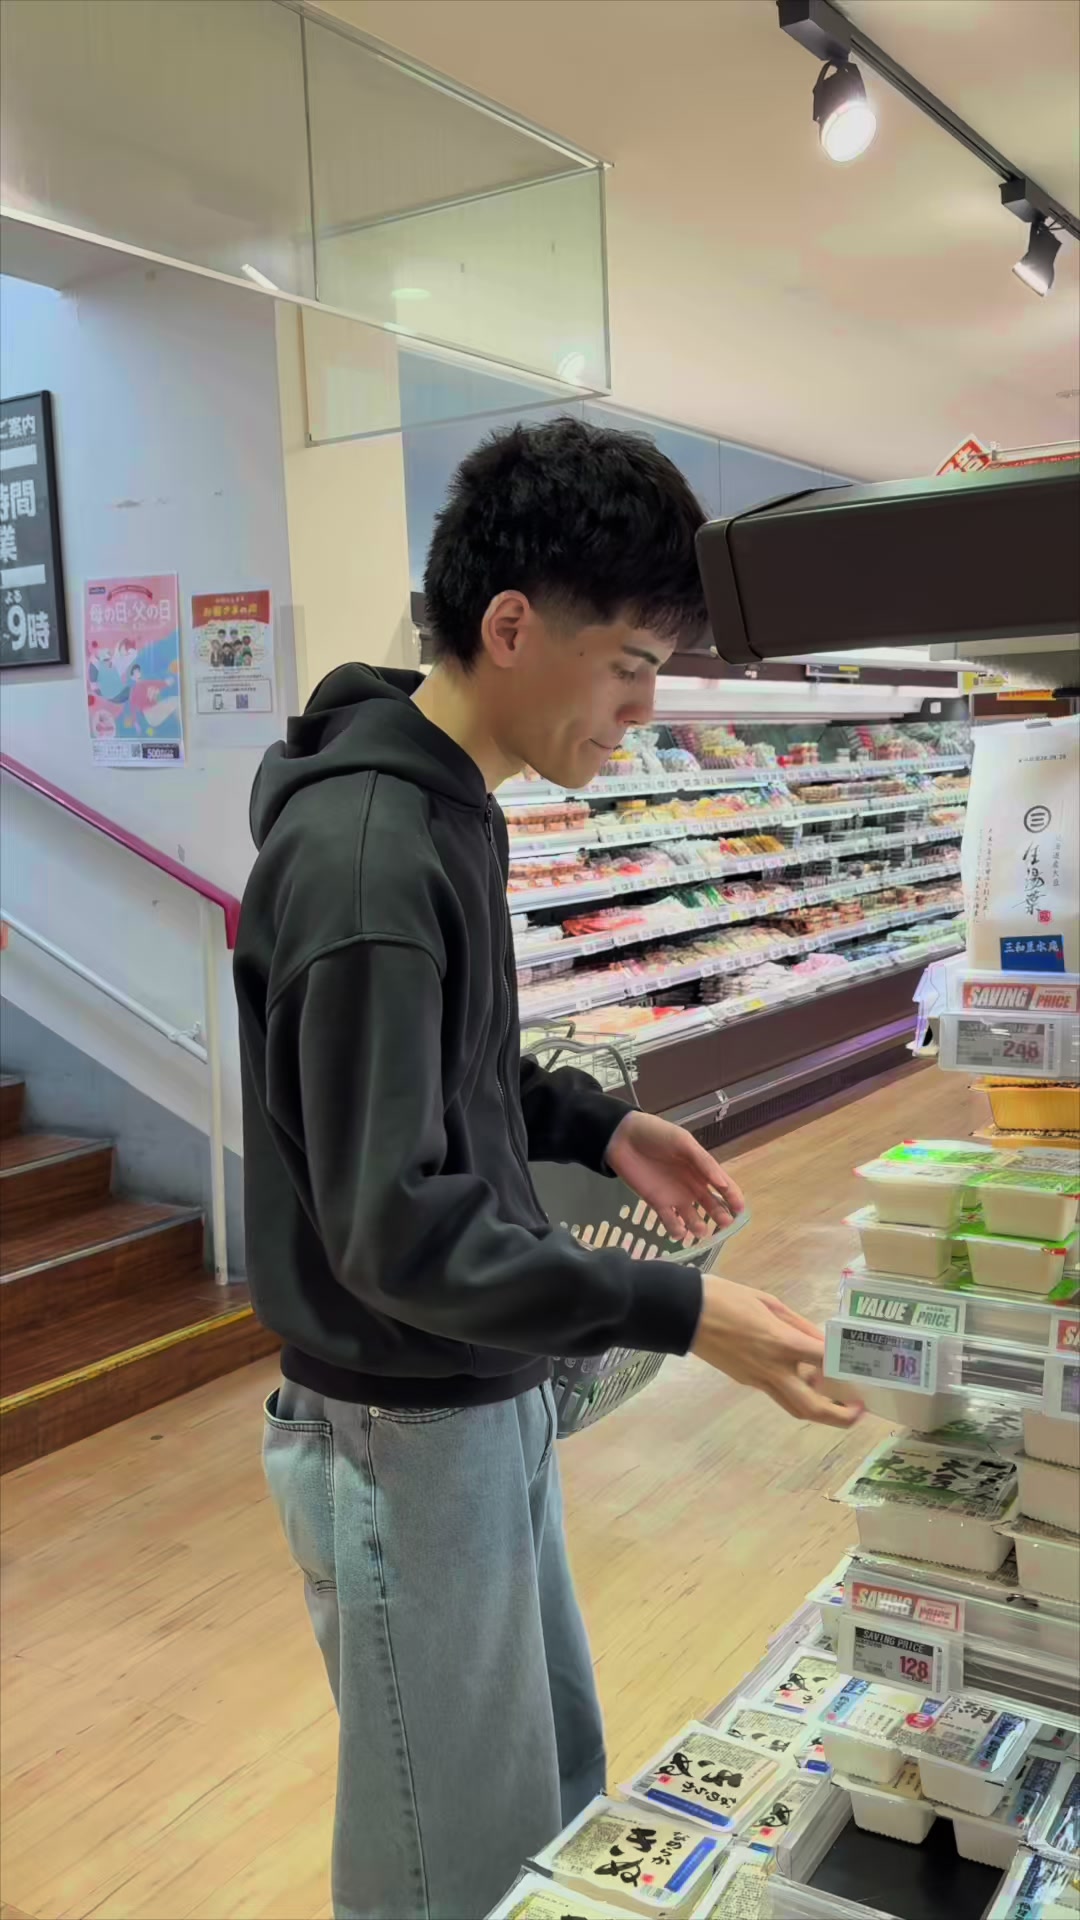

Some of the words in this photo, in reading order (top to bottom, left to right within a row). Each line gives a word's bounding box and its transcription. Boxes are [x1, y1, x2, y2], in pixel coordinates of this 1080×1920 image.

[970, 985, 1029, 1009] SAVING
[1037, 994, 1073, 1009] PRICE
[1003, 1039, 1040, 1060] 248
[856, 1296, 909, 1321] VALUE
[917, 1311, 952, 1328] PRICE
[863, 1630, 896, 1646] SAVING
[897, 1640, 925, 1654] PRICE
[899, 1655, 929, 1680] 128
